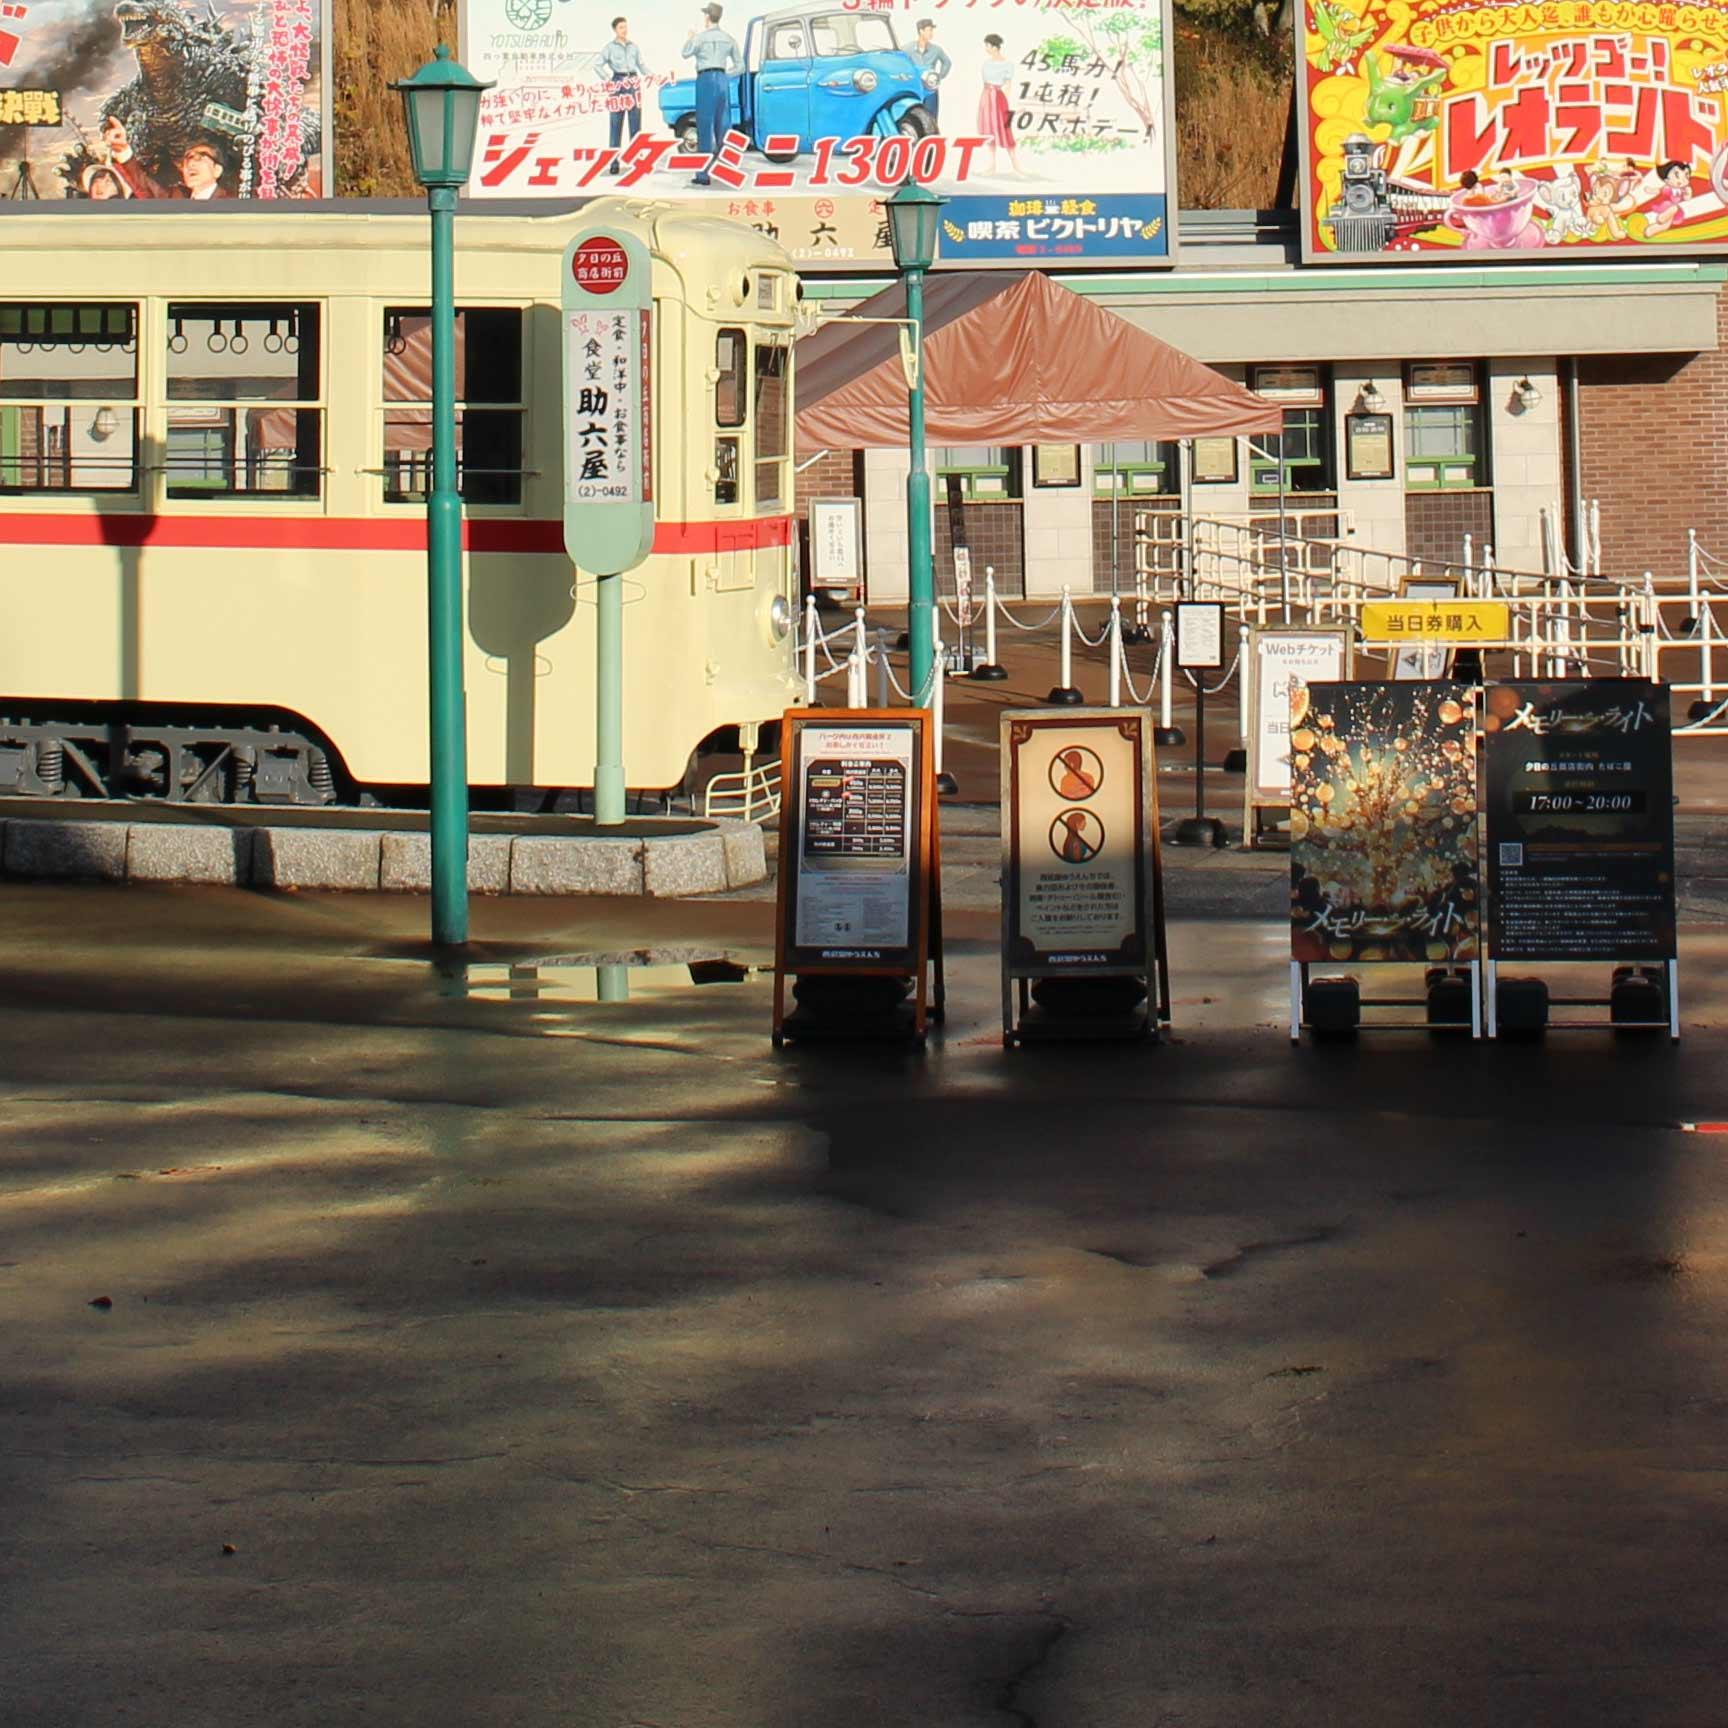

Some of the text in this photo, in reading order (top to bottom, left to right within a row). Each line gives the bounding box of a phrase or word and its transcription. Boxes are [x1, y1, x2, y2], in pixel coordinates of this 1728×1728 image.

[1021, 49, 1124, 80] 45馬力!
[1488, 33, 1671, 88] レッツゴー!
[1447, 82, 1720, 179] レオランド
[728, 200, 776, 216] お食事
[1008, 199, 1096, 217] 珈琲 軽食
[968, 216, 1144, 240] 喫茶 ビクトリヤ
[577, 252, 623, 265] 夕日の丘
[577, 266, 624, 280] 商店街前
[576, 337, 609, 482] 食堂 助六屋
[578, 485, 628, 498] (2)-0492
[1386, 615, 1483, 632] 当日券購入
[1265, 643, 1335, 656] Webチケット
